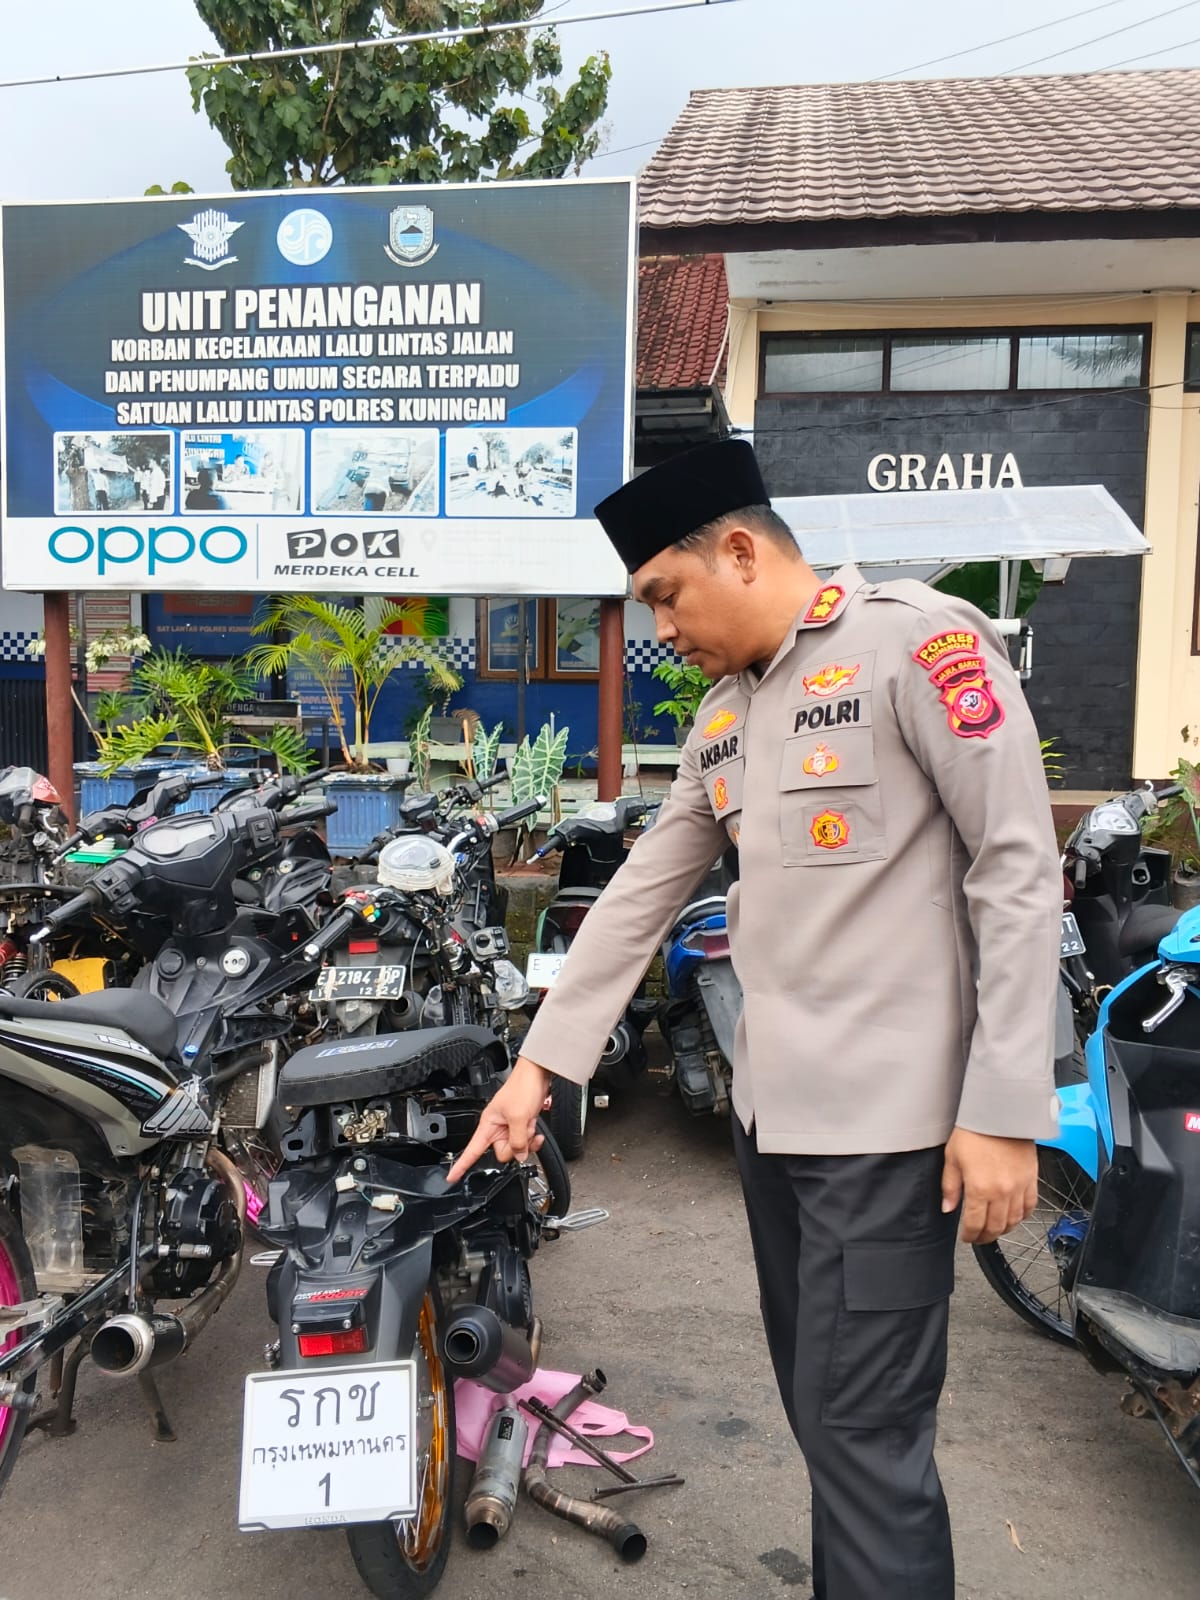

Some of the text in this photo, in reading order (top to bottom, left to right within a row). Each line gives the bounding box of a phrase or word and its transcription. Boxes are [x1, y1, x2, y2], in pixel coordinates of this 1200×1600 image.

[142, 283, 480, 332] UNIT PENANGANAN
[111, 331, 514, 361] KORBAN KECELAKAAN LALU LINTAS JALAN
[105, 364, 520, 393] DAN PENUMPANG UMUM SECARA TERPADU
[117, 397, 506, 425] SATUAN LALU LINTAS POLRES KUNINGAN
[867, 453, 1024, 491] GRAHA
[286, 529, 401, 559] POK
[274, 564, 420, 577] MERDEKA CELL
[919, 633, 975, 661] POLRES
[926, 642, 974, 663] KUNINGAN
[794, 698, 860, 733] POLRI
[700, 735, 739, 773] AKBAR
[337, 970, 373, 985] 2184
[279, 1380, 381, 1428] รกช
[252, 1434, 407, 1469] กรุงเทพมหานคร
[318, 1472, 331, 1507] 1
